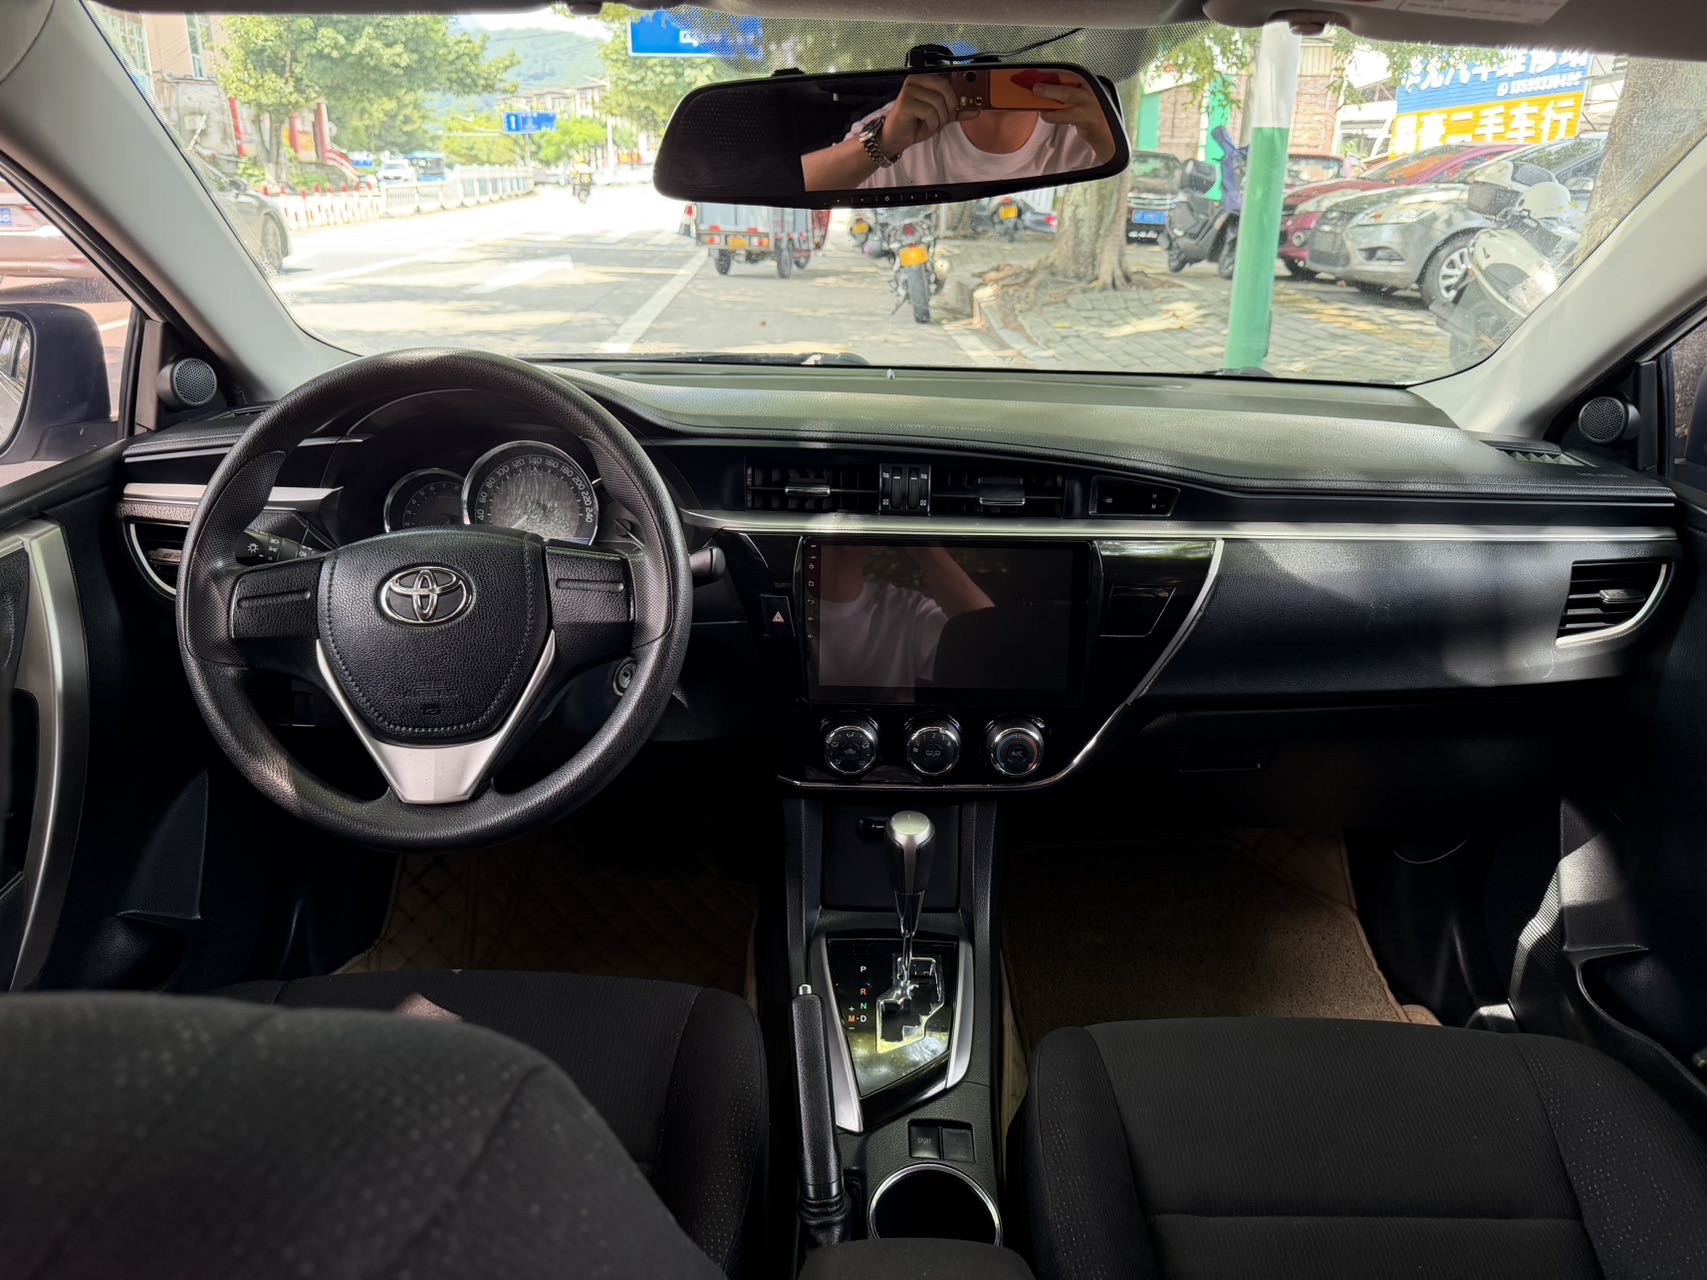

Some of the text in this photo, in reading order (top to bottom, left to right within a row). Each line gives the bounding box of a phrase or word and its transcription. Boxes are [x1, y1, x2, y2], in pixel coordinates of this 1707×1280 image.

[528, 457, 543, 465] 140
[545, 458, 559, 469] 160
[496, 464, 510, 477] 100
[560, 464, 574, 477] 180
[485, 477, 497, 489] 80
[572, 476, 586, 491] 200
[479, 491, 488, 503] 60
[580, 490, 592, 506] 220
[477, 509, 485, 521] 40
[585, 507, 594, 523] 240
[860, 988, 867, 996] R
